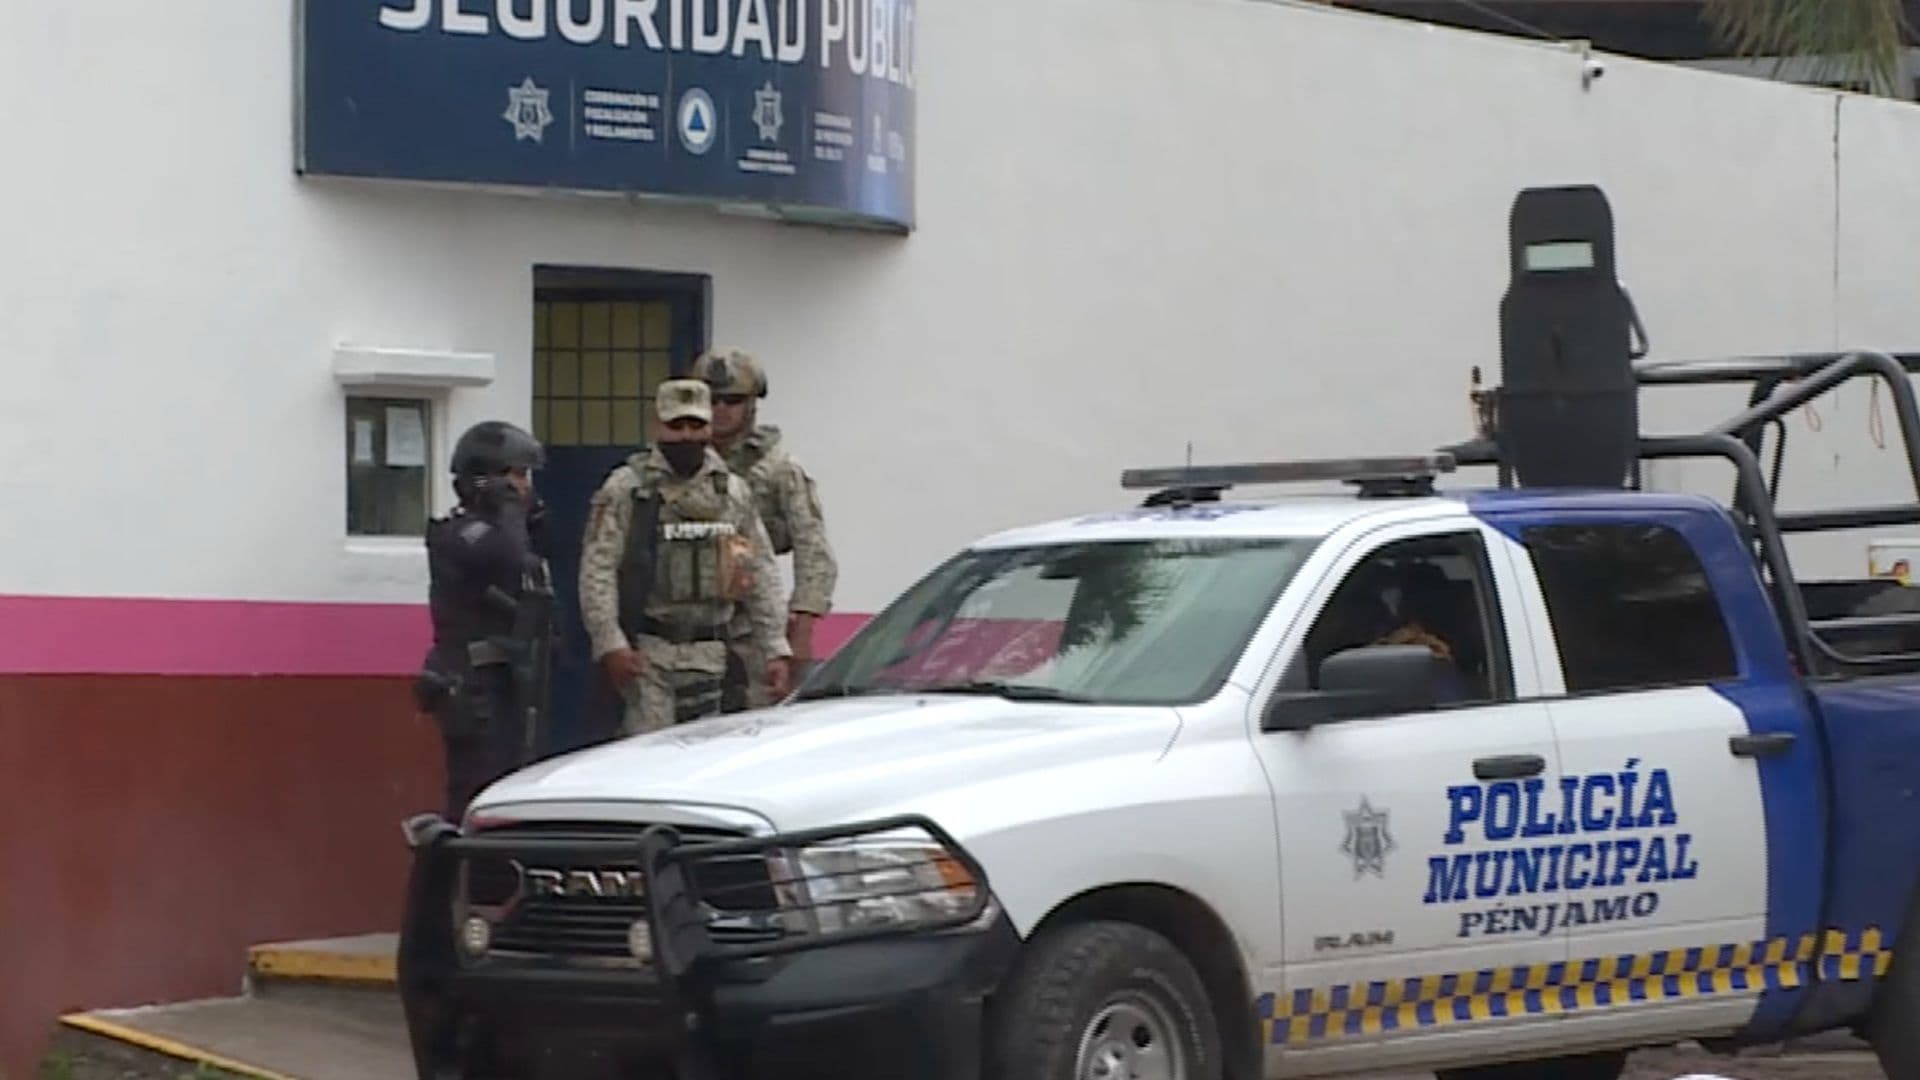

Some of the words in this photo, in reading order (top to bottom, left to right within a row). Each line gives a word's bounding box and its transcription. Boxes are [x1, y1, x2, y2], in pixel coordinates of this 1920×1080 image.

[1444, 757, 1678, 845] POLICÍA
[526, 867, 645, 897] RAM
[1423, 833, 1699, 905] MUNICIPAL
[1458, 890, 1660, 938] PÉNJAMO
[1314, 930, 1395, 952] RAM
